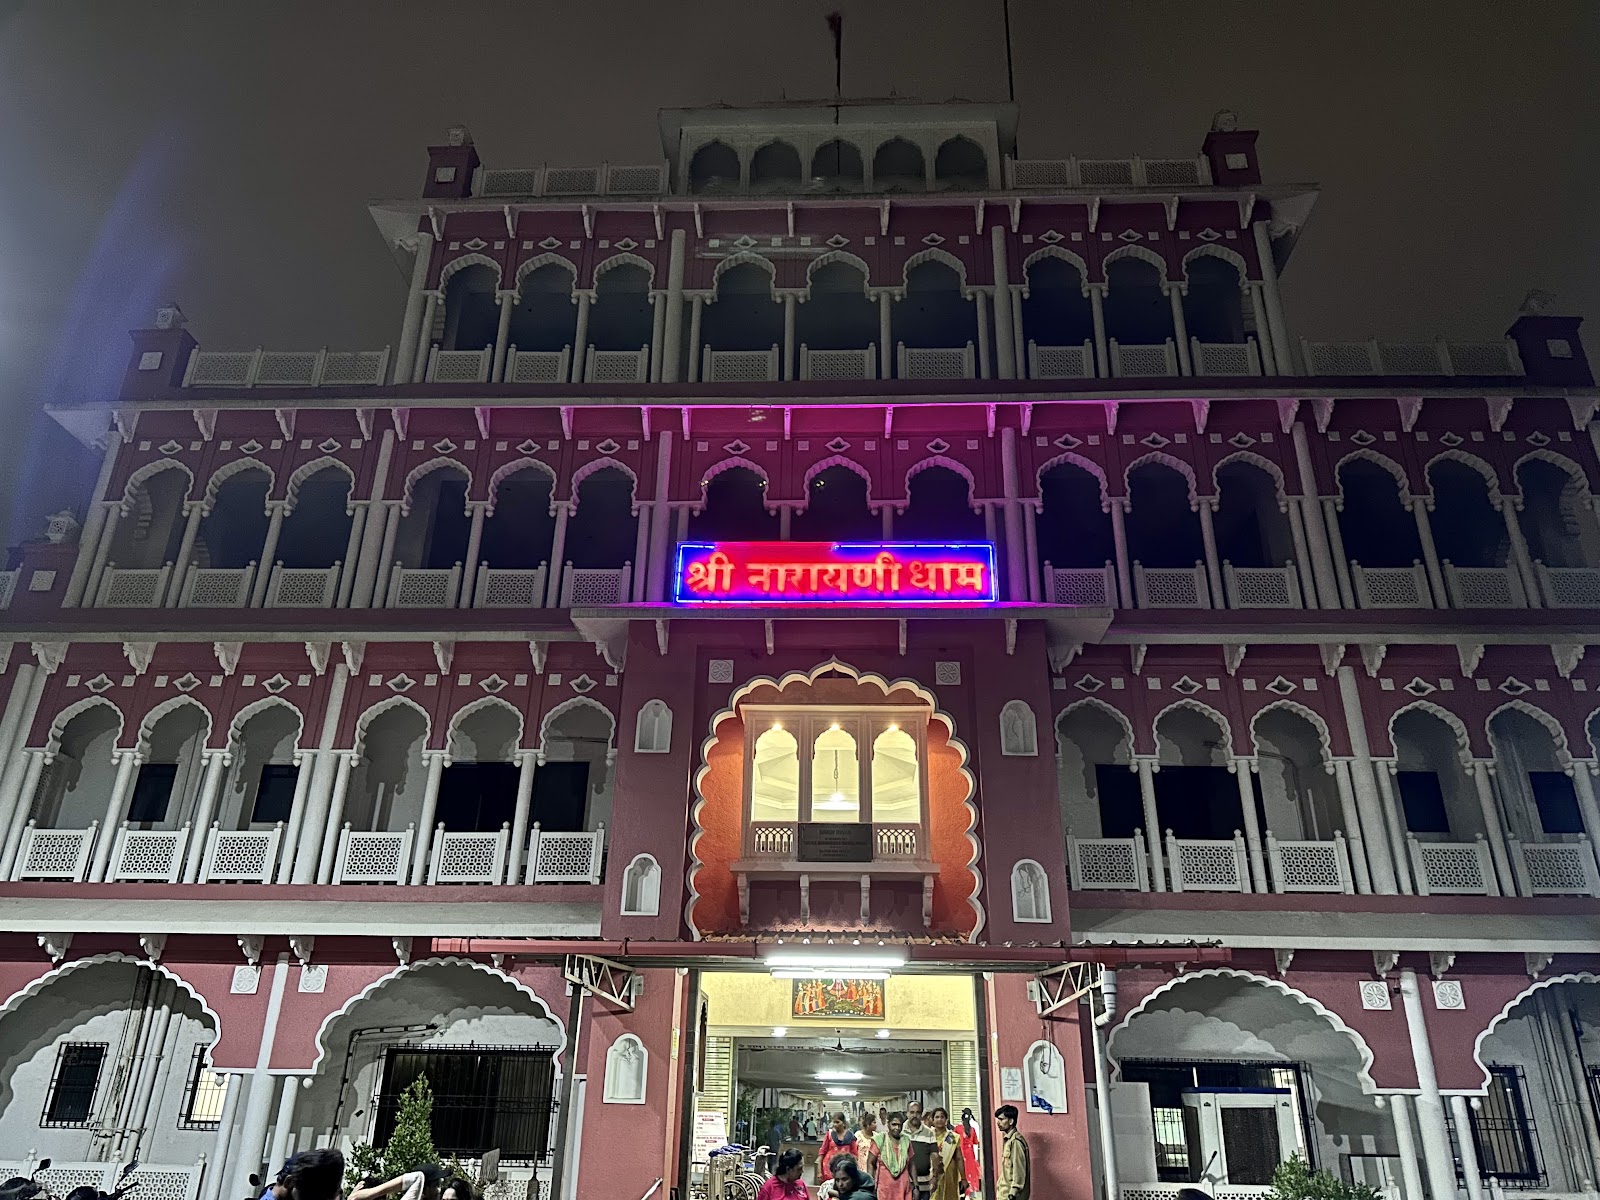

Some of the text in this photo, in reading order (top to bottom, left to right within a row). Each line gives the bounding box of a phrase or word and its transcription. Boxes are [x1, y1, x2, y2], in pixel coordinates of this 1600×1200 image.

[686, 551, 986, 593] श्री नारायणी धाम
